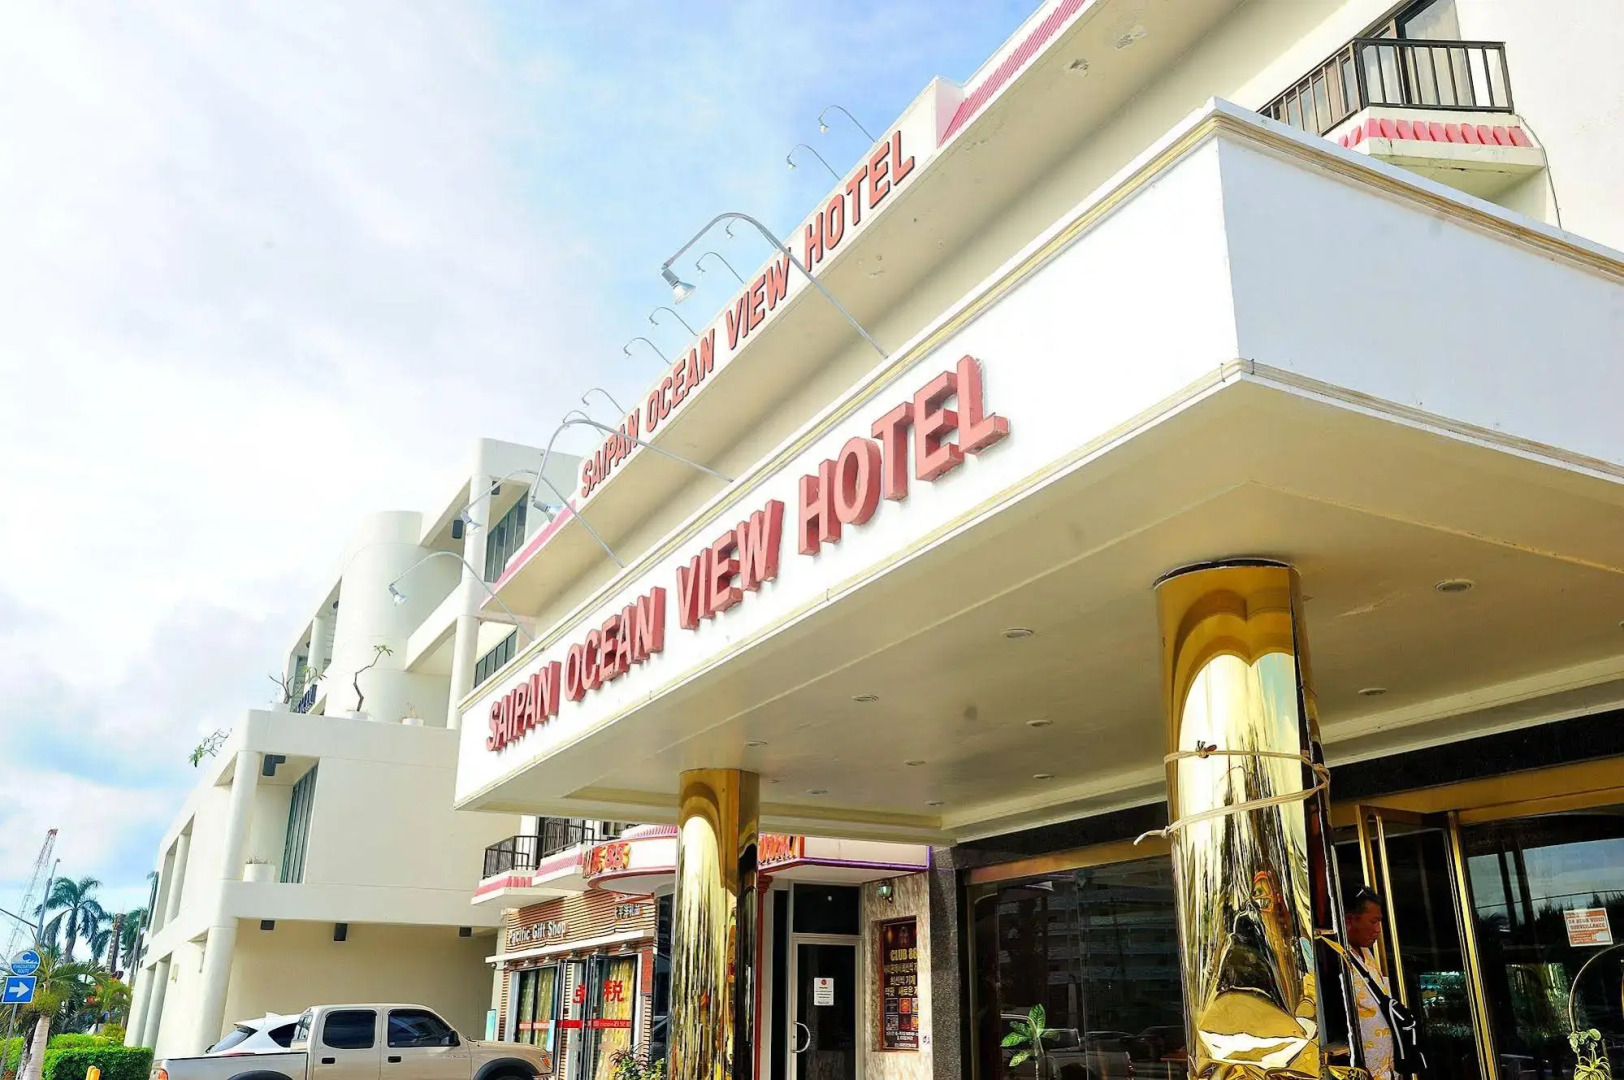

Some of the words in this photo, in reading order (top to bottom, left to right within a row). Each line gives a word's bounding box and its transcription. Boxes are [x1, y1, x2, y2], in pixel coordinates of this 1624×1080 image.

[580, 407, 640, 497] SAIPAN
[645, 328, 715, 433] OCEAN
[725, 247, 791, 350] VIEW
[804, 130, 915, 273] HOTEL
[486, 660, 562, 752] SAIPAN
[564, 586, 666, 702] OCEAN
[676, 499, 785, 630] VIEW
[798, 354, 1010, 556] HOTEL
[509, 927, 531, 945] Pacific
[532, 922, 545, 939] Gift
[547, 920, 566, 938] Shop
[890, 949, 907, 961] CLUB
